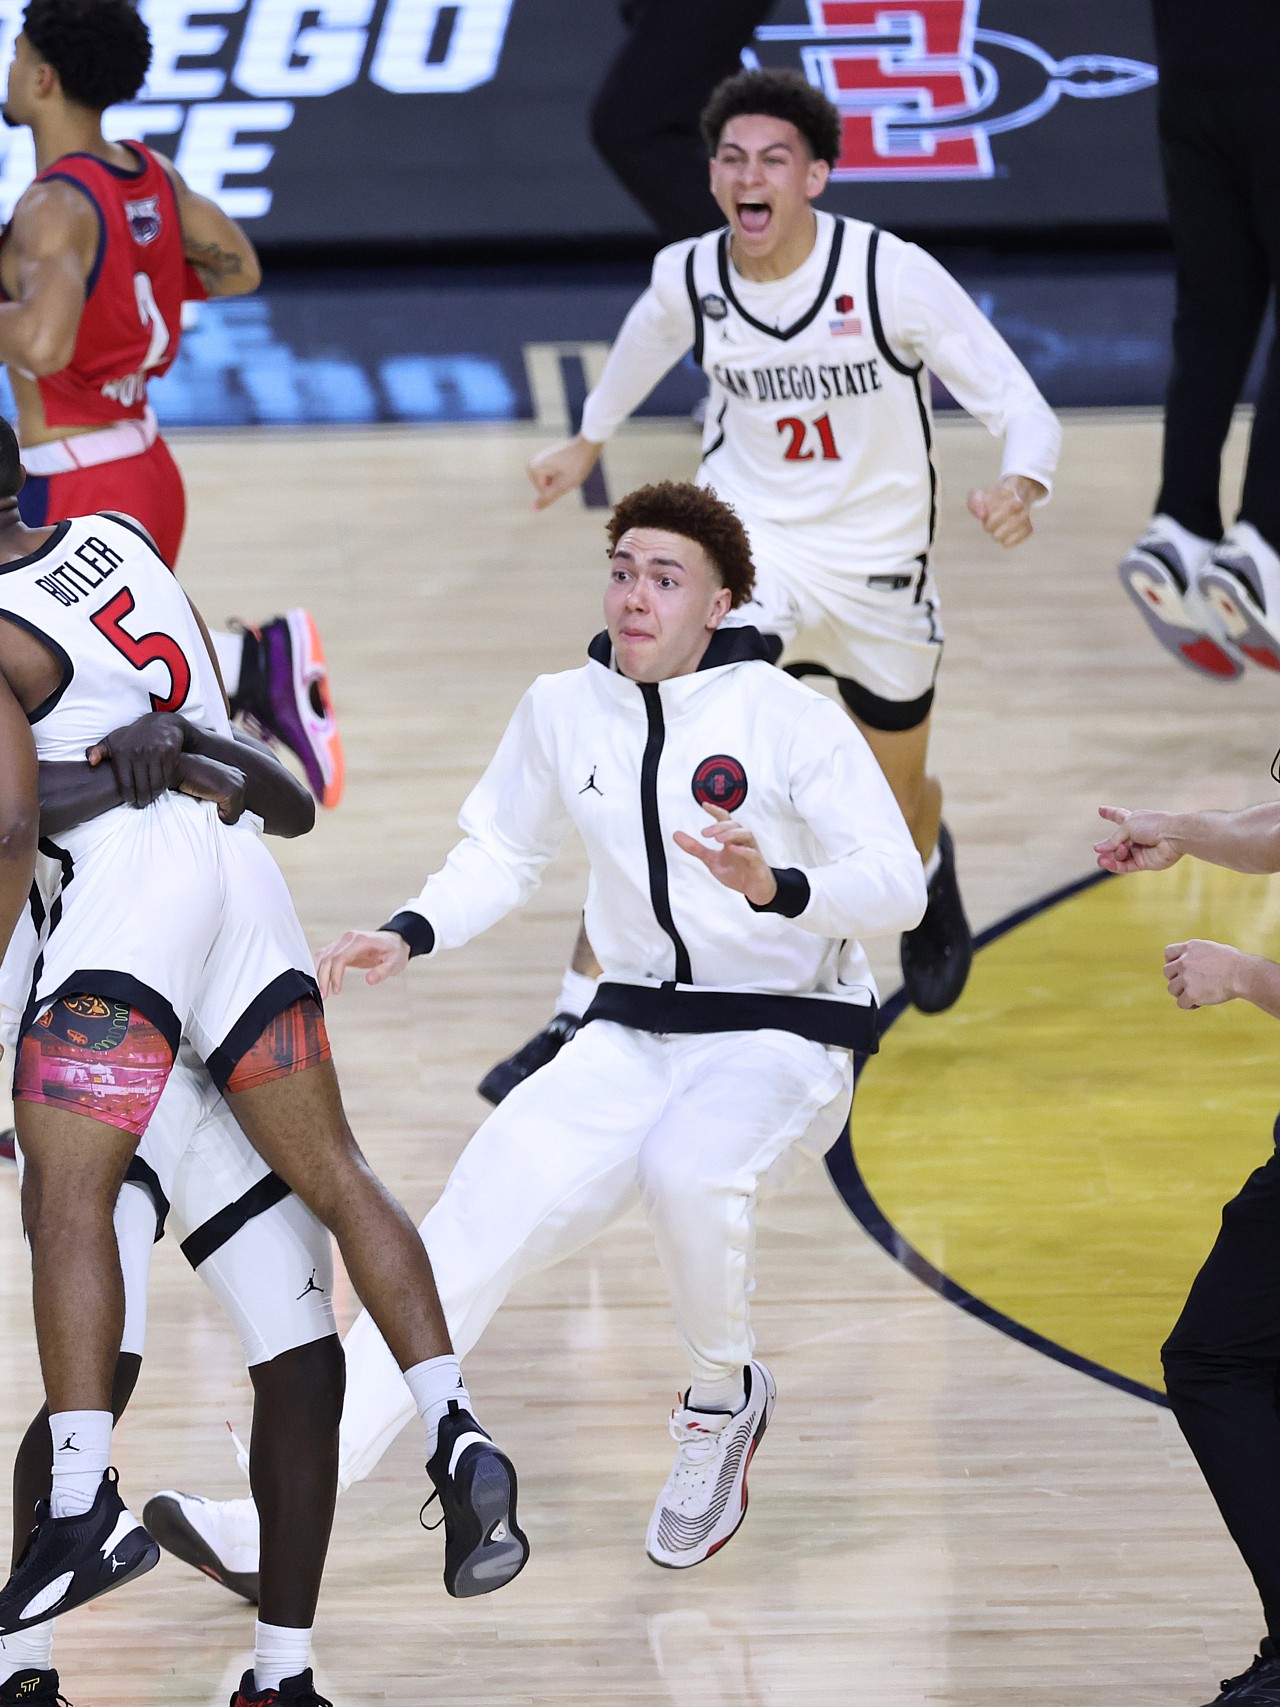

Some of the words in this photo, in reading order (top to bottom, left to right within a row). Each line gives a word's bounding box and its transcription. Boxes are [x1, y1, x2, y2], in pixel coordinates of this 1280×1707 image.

[753, 364, 816, 402] DIEGO
[819, 358, 882, 401] STATE
[776, 411, 841, 463] 21
[34, 536, 125, 607] BUTLER
[89, 585, 192, 713] 5
